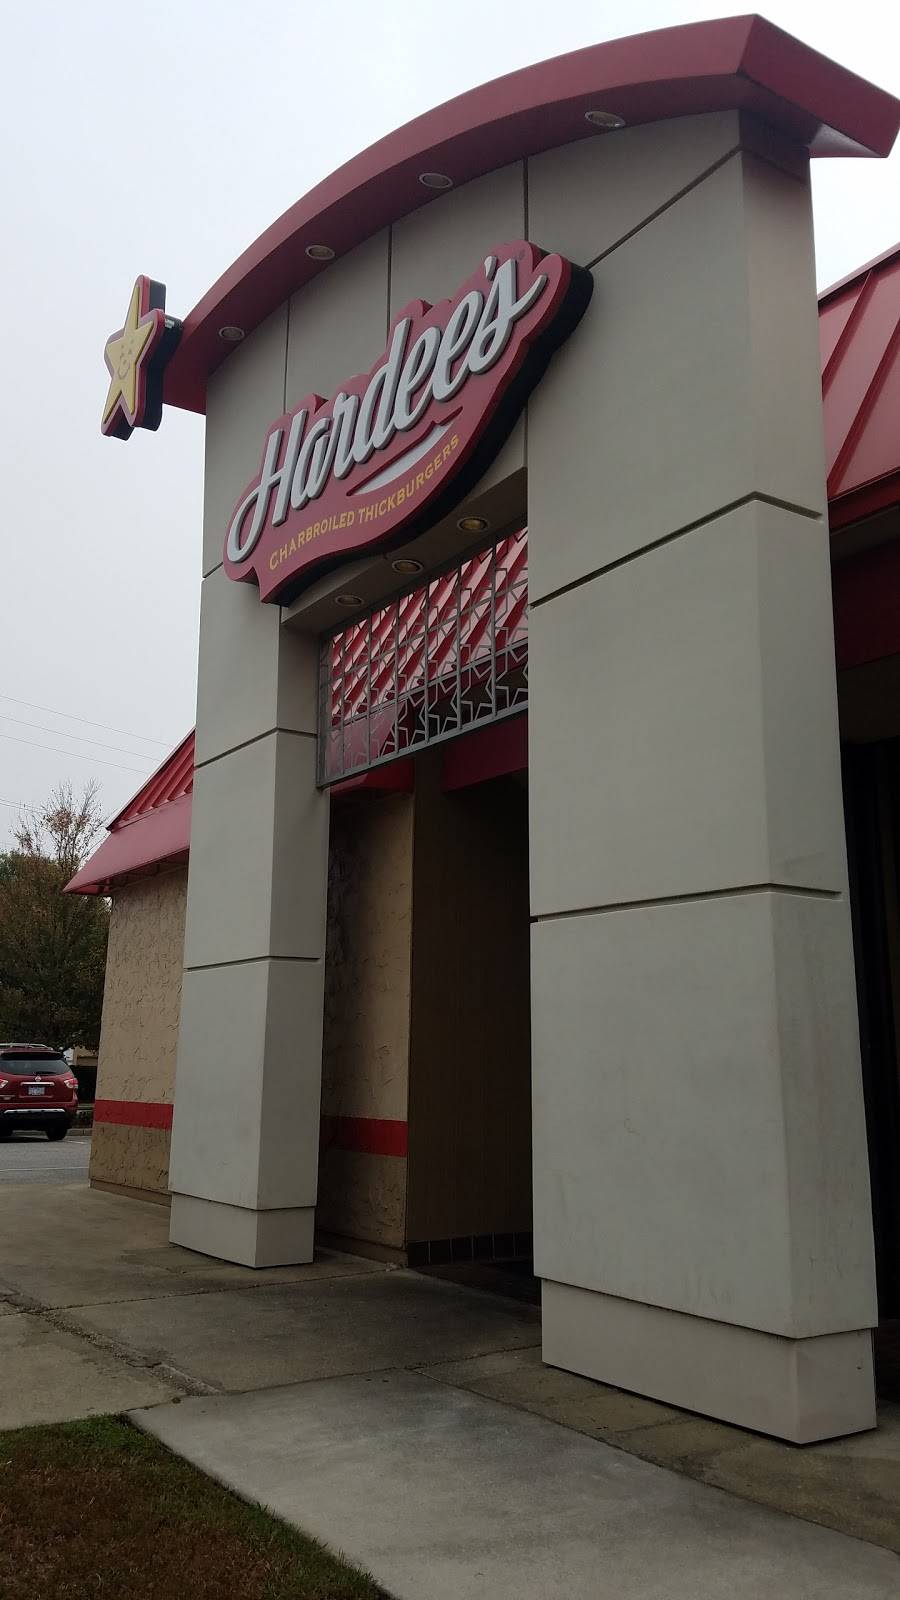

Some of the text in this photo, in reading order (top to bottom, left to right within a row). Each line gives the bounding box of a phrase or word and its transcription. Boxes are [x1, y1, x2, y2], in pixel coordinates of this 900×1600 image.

[227, 256, 548, 563] Hardee's
[269, 434, 460, 570] CHARBROILED THICKBURGERS
